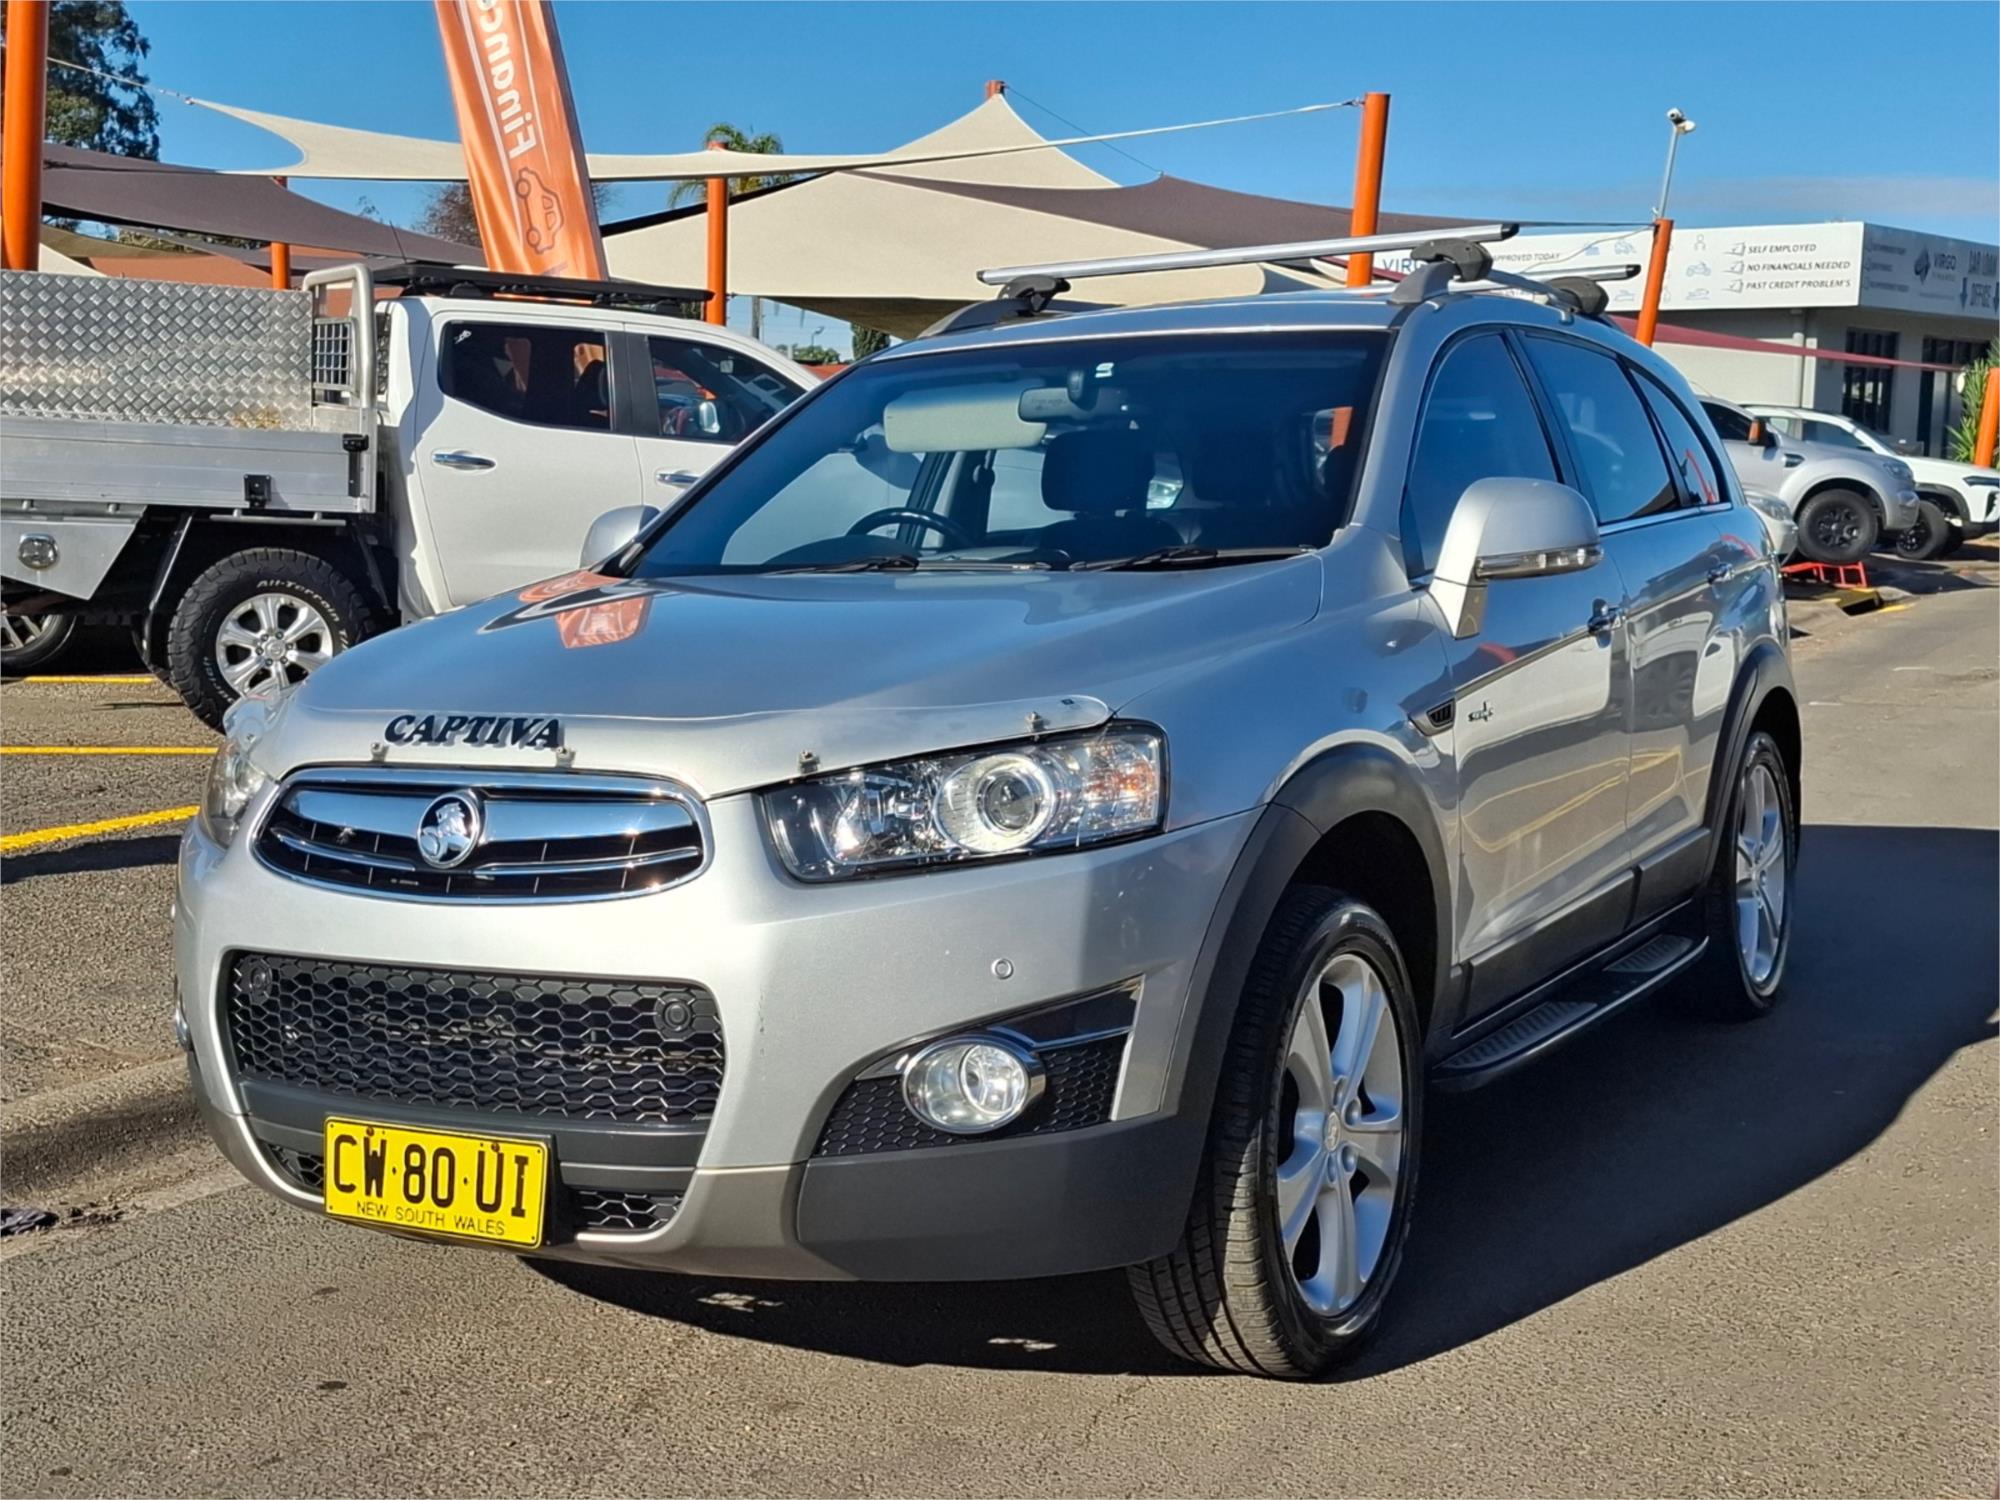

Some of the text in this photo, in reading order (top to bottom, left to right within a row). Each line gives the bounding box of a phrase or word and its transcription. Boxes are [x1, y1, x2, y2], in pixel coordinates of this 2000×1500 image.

[1747, 243, 1817, 254] SELF EMPLOYED
[1382, 258, 1419, 272] VIR
[1746, 260, 1851, 272] NO FINANCIALS NEEDED
[1745, 281, 1767, 290] PAST
[1768, 280, 1800, 289] CREDIT
[256, 579, 340, 622] All-Terrain
[384, 714, 562, 749] CAPTIVA
[356, 1200, 506, 1236] NEW SOUTH WALES
